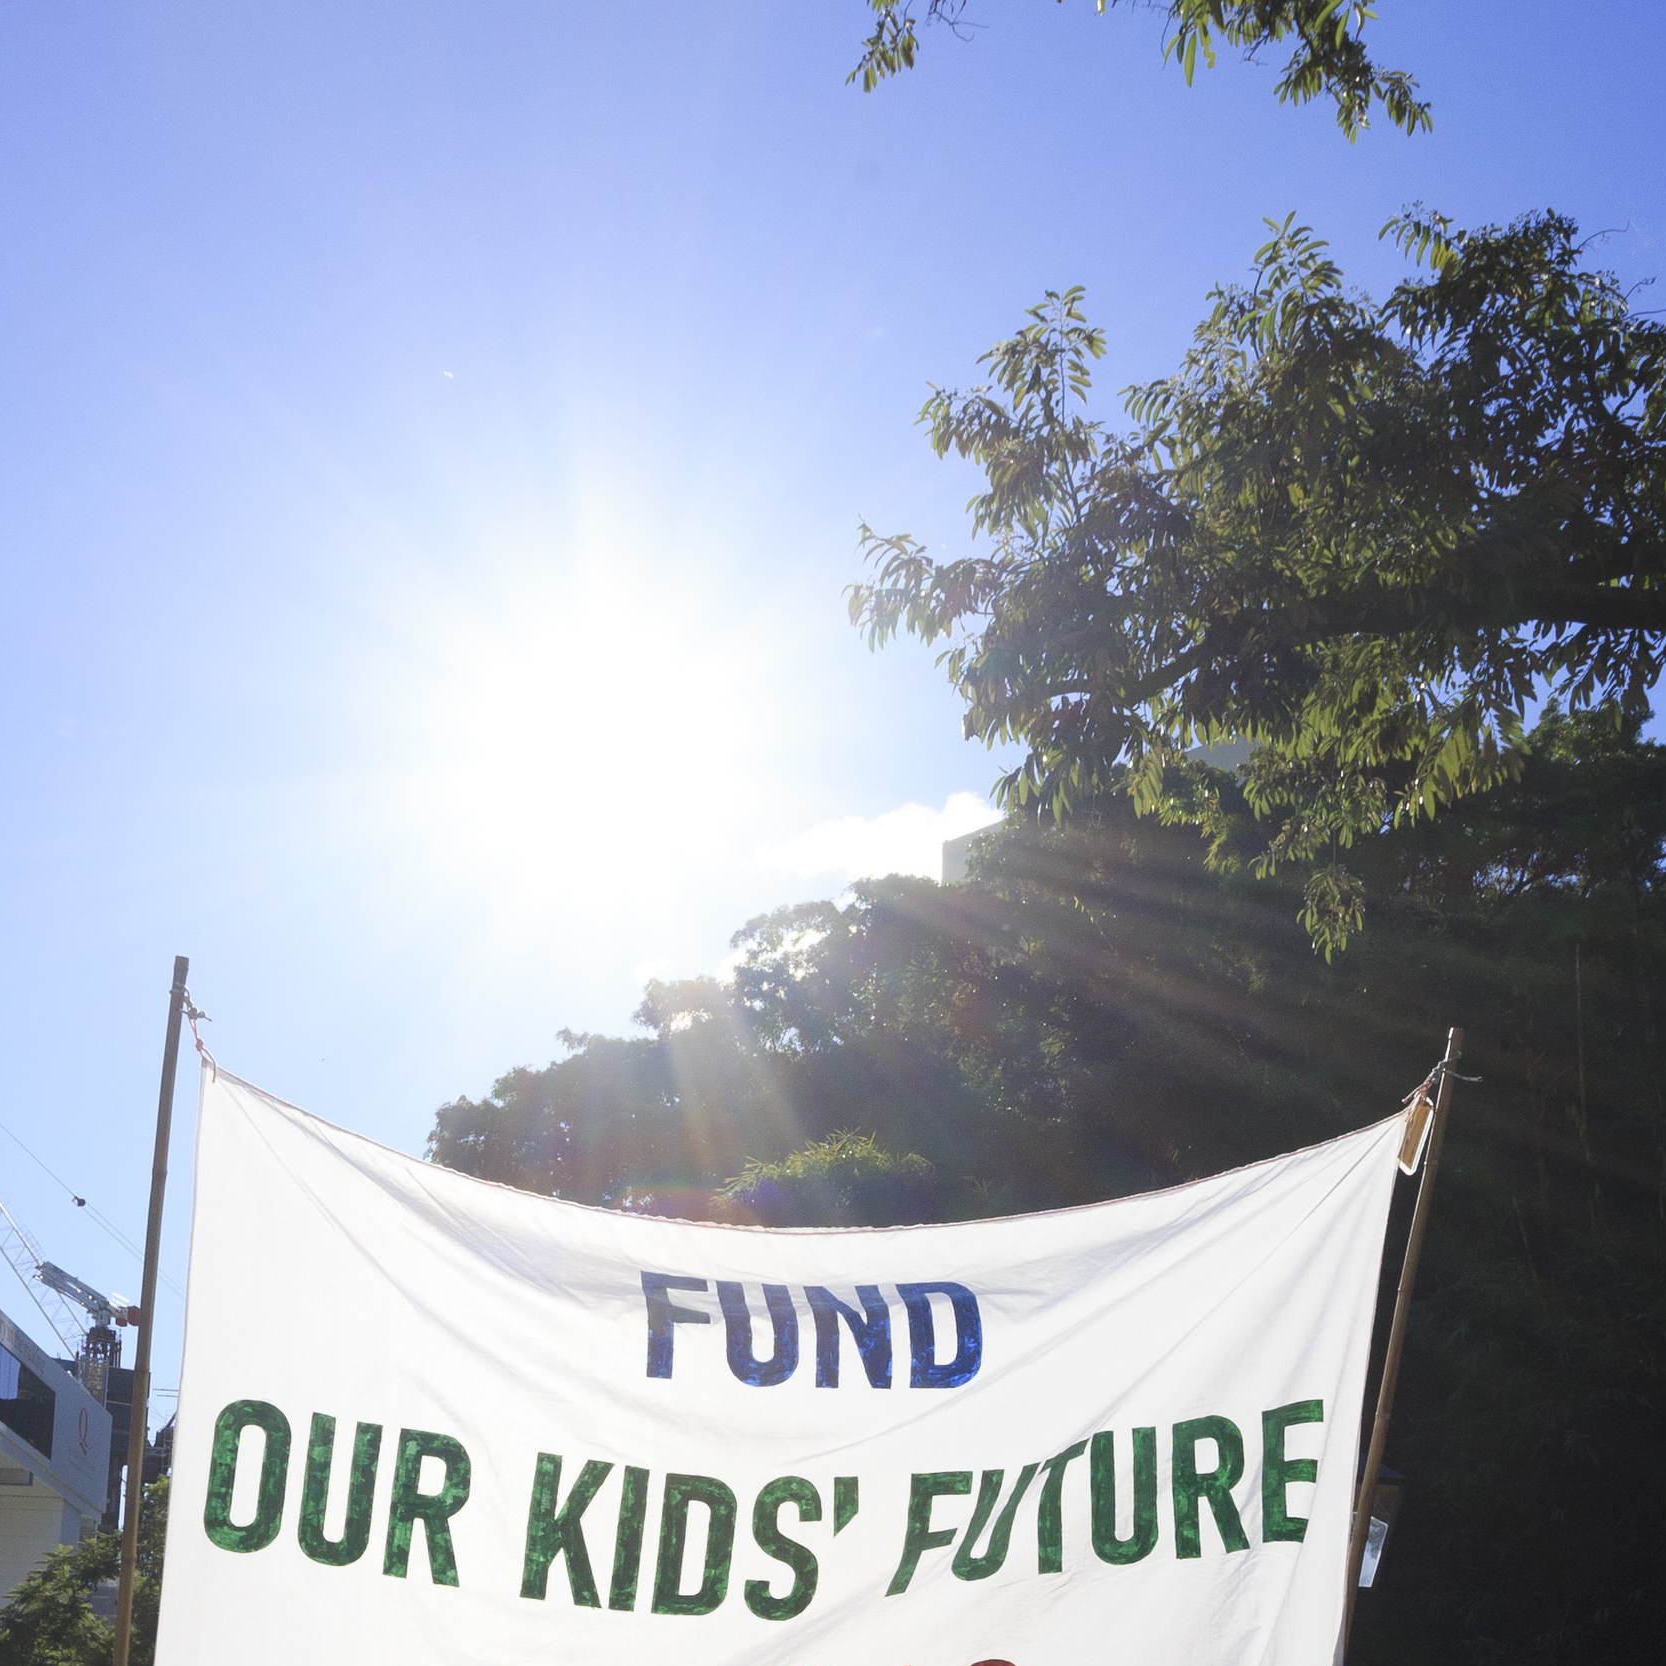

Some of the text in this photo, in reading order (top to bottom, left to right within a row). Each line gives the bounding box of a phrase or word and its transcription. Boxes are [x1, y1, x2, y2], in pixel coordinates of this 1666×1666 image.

[642, 1271, 983, 1390] FUND
[202, 1398, 1325, 1622] OUR KIDS' FUTURE
